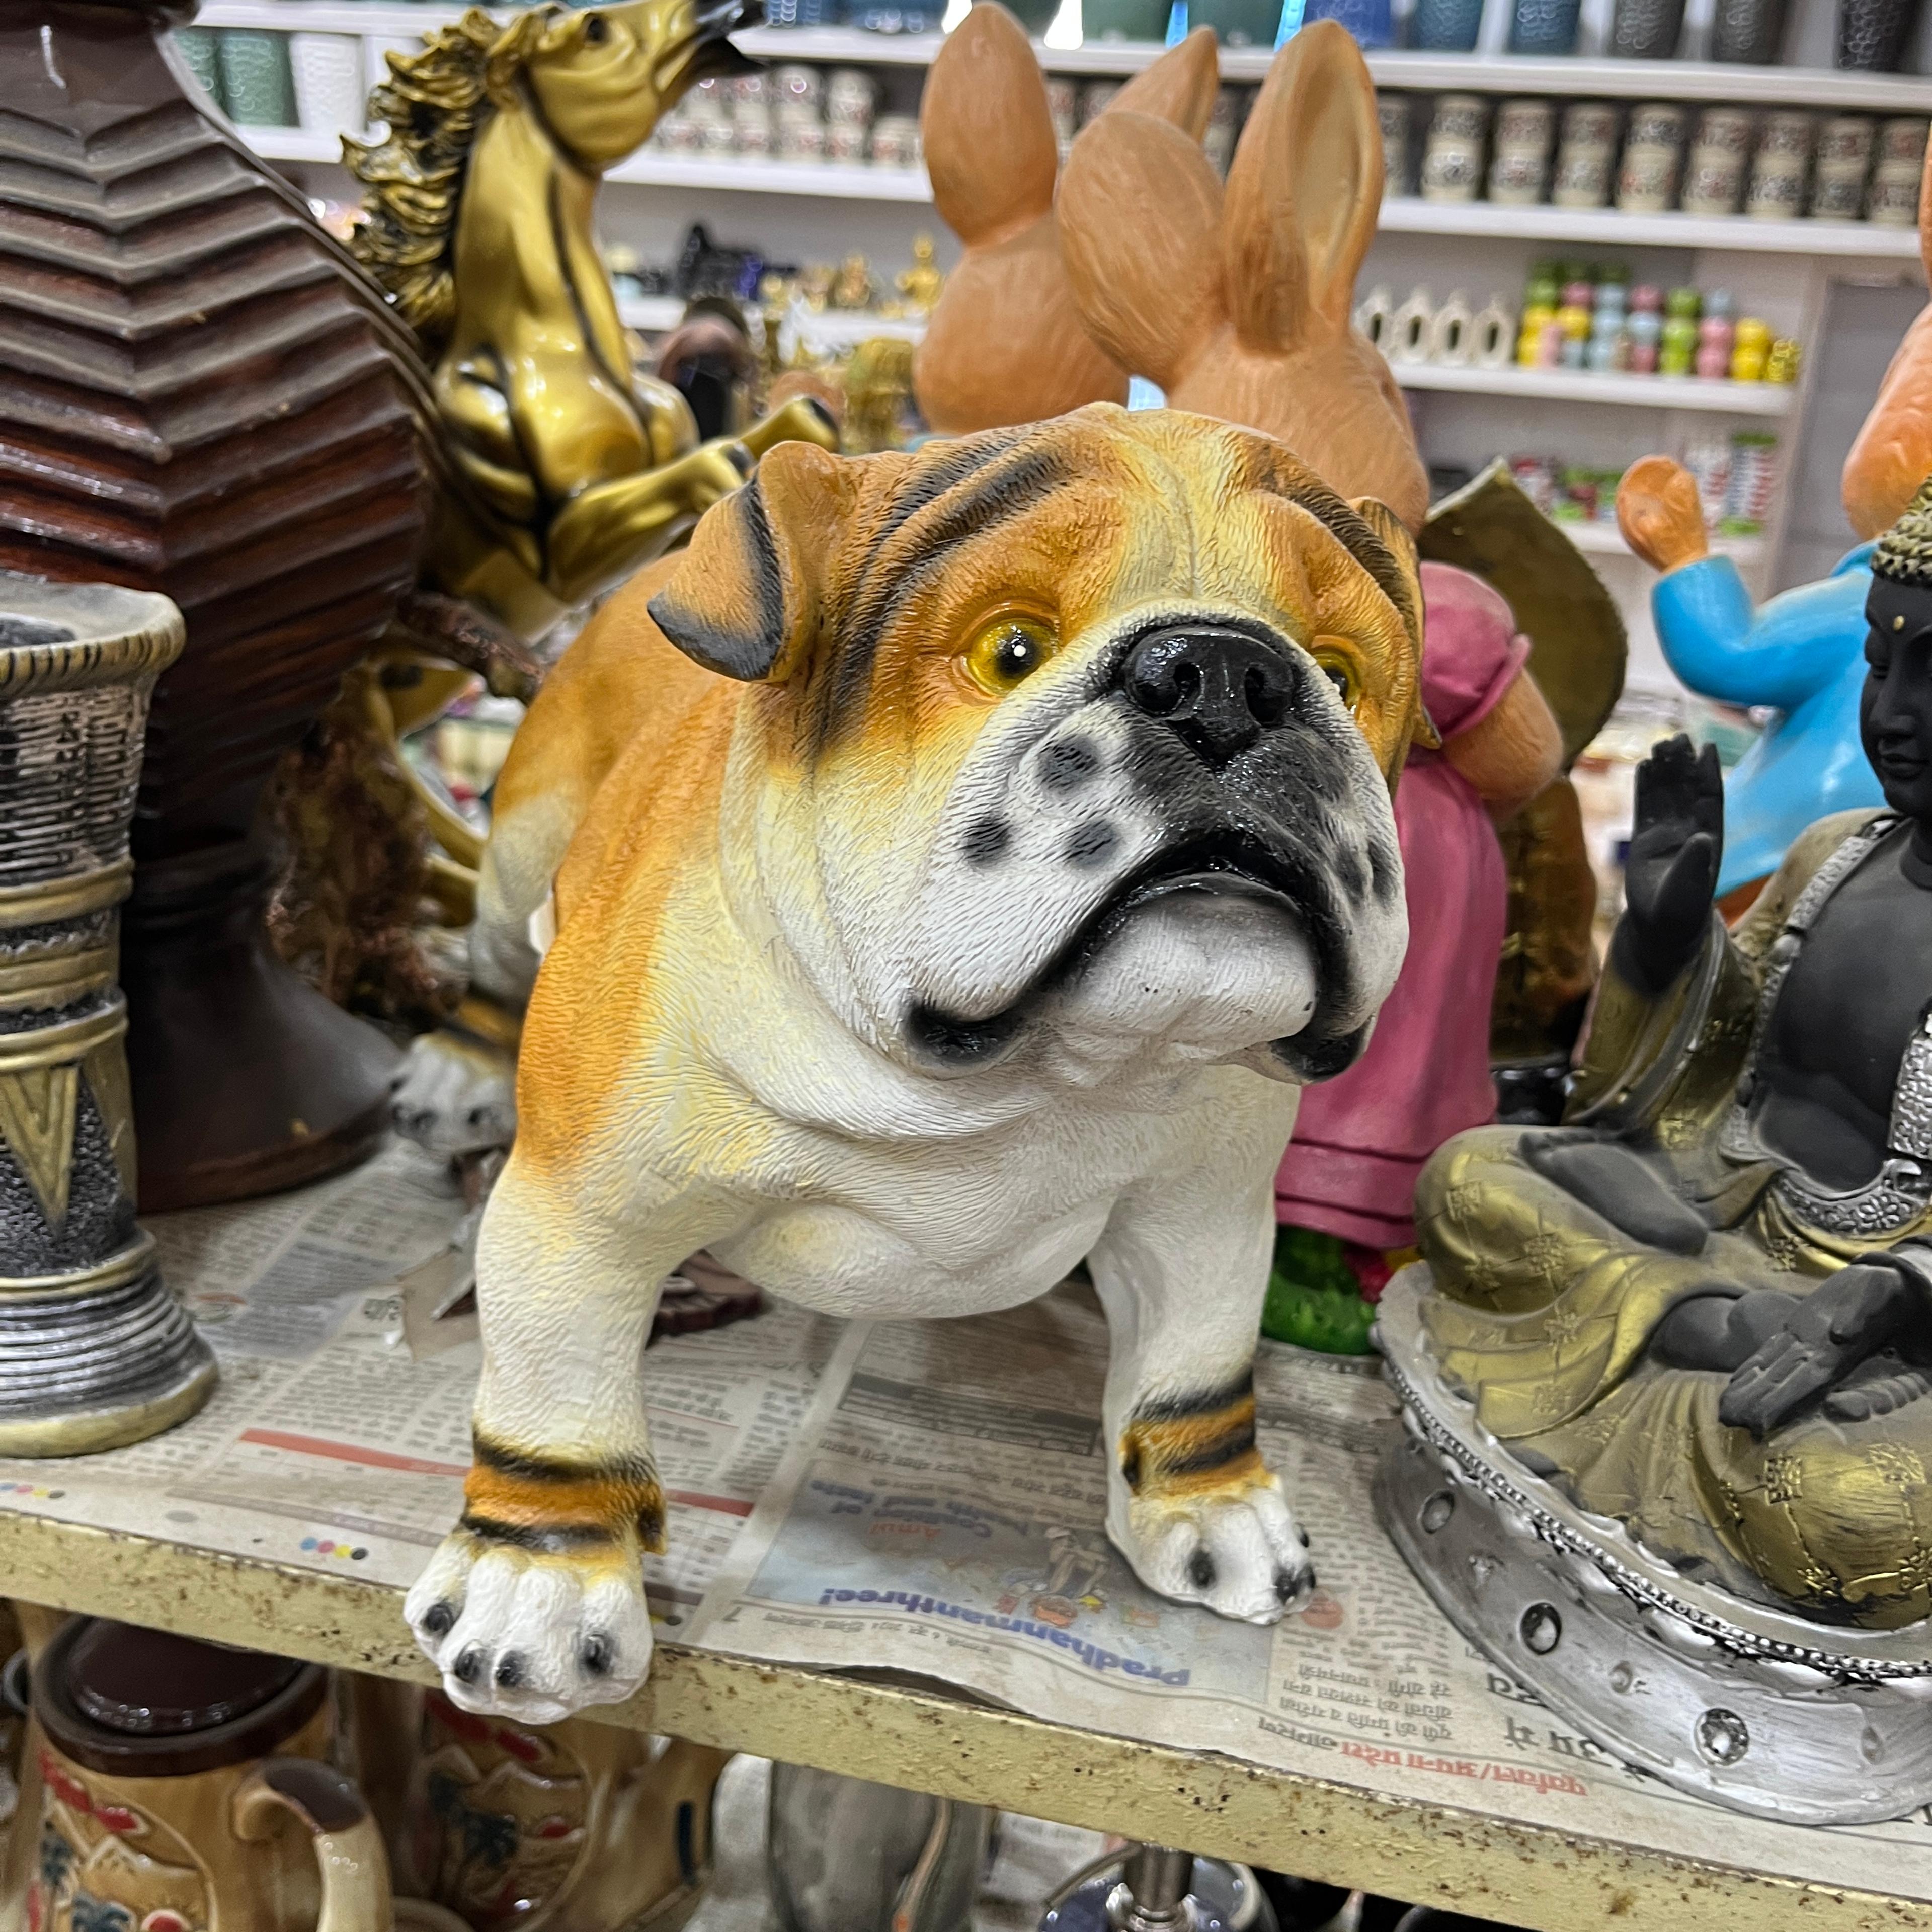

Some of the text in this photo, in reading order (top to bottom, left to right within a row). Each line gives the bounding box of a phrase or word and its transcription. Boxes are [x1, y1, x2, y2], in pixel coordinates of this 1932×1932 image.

[818, 1588, 1190, 1686] Pradhanmanthree!
[1283, 1680, 1312, 1697] बना
[1378, 1699, 1400, 1713] को
[1329, 1709, 1343, 1721] व
[1395, 1722, 1418, 1737] की
[1504, 1717, 1540, 1751] में
[1340, 1742, 1402, 1767] प्रदेश
